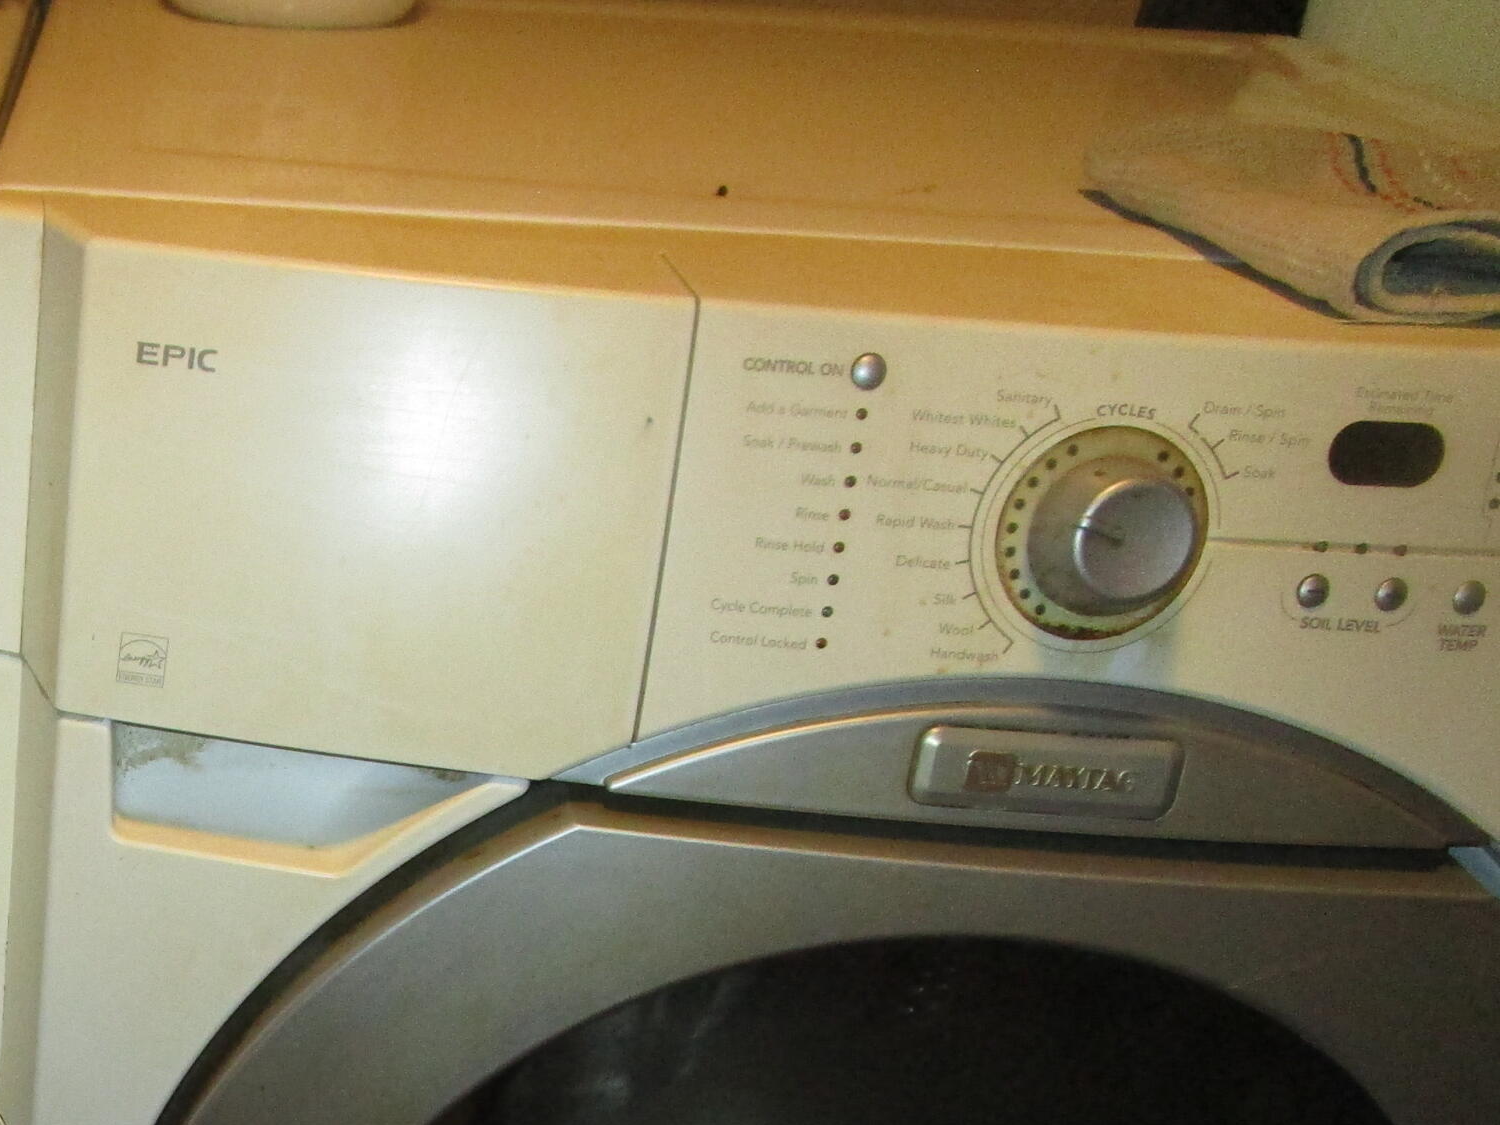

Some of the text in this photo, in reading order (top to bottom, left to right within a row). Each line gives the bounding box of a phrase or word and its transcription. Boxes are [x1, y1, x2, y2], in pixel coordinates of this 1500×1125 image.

[136, 341, 218, 373] EPIC
[743, 357, 846, 377] CONTROL ON
[997, 389, 1051, 406] Sanitary
[913, 409, 1017, 428] Whitest Whites
[1097, 403, 1156, 421] CYCLES
[910, 442, 989, 461] Heavy Duty
[802, 474, 836, 488] Wash
[796, 508, 829, 521] Rinse
[877, 513, 956, 530] Rapid Wash
[755, 538, 825, 553] Rinse Hold
[895, 554, 951, 570] Delicate
[790, 571, 818, 586] Spin
[933, 593, 957, 605] Silk
[710, 598, 812, 618] Cycle Complete
[939, 622, 974, 636] Wool
[1300, 616, 1380, 633] SOIL LEVEL
[1437, 624, 1487, 639] WATER
[709, 630, 807, 650] Control Locked
[1438, 639, 1478, 652] TEMP
